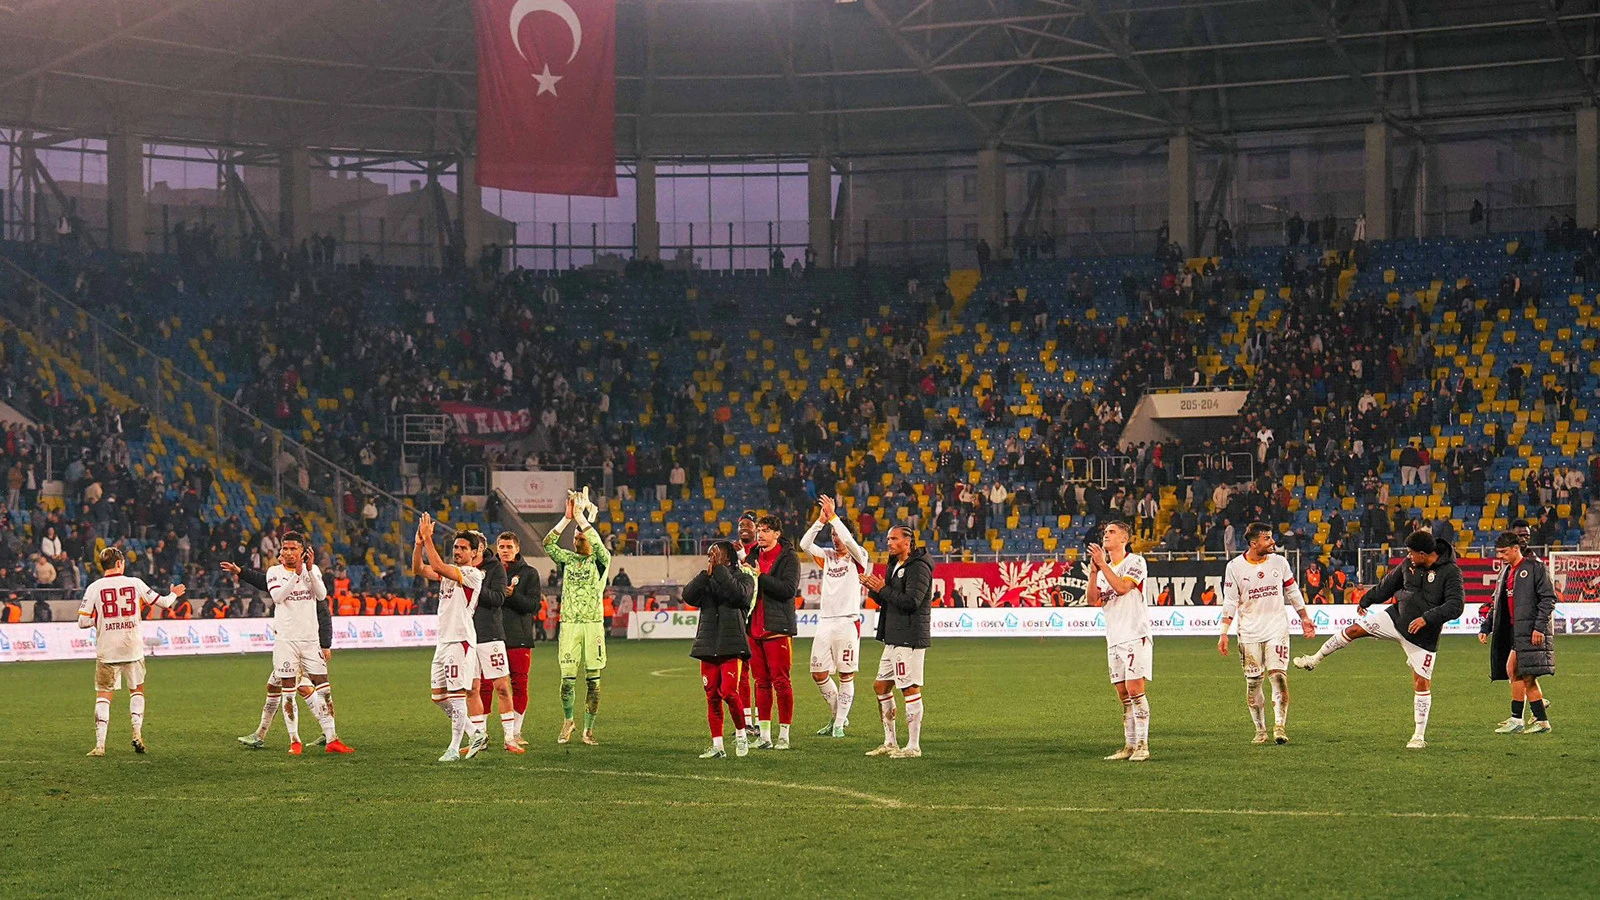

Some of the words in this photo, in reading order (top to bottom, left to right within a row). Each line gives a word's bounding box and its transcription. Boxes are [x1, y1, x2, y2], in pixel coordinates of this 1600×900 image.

[1180, 399, 1219, 410] 205-204
[100, 586, 136, 618] 83
[842, 649, 854, 661] 21
[1275, 645, 1288, 659] 42
[490, 653, 505, 667] 53
[1127, 653, 1135, 667] 7
[1423, 653, 1432, 667] 8
[444, 664, 459, 678] 20
[895, 662, 906, 676] 10
